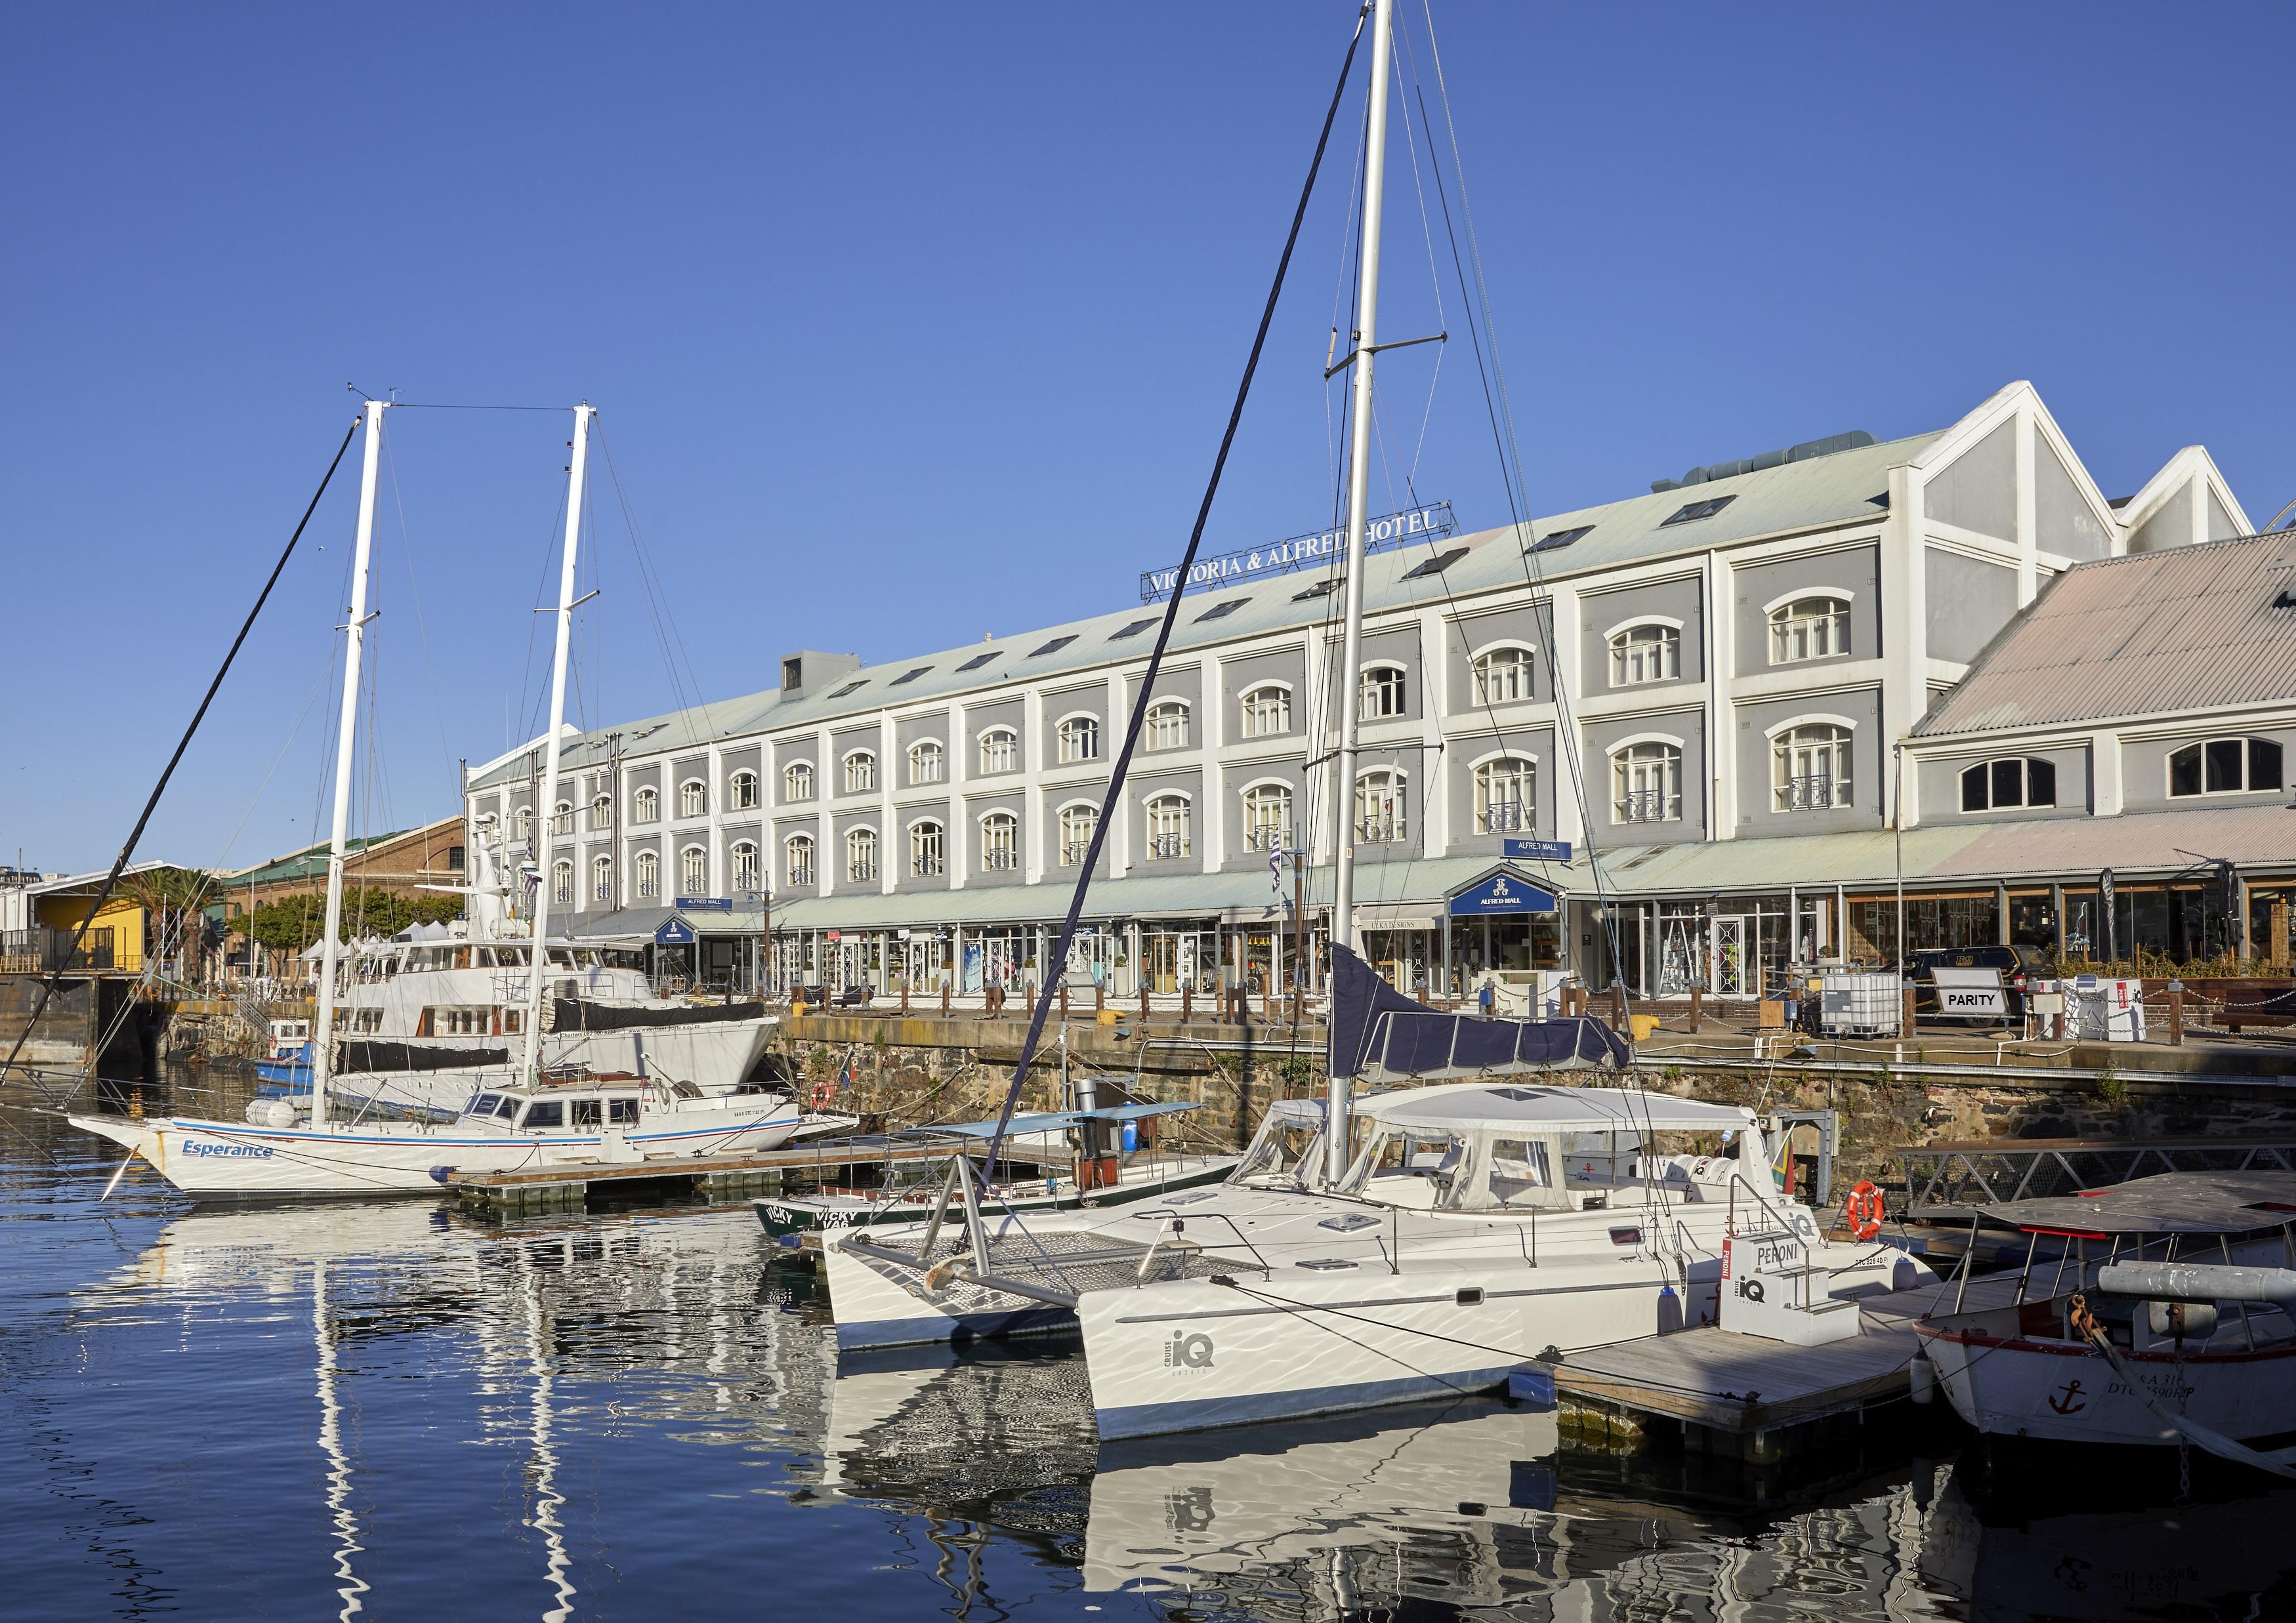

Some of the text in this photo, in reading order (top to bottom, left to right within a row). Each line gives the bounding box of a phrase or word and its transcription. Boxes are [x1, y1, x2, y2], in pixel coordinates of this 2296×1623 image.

[1150, 510, 1438, 591] VICTORIA & ALFRED HOTEL
[1948, 995, 1995, 1006] PARITY
[182, 1140, 274, 1158] Esperance
[1694, 1165, 1705, 1176] iQ
[766, 1206, 793, 1225] VICKY
[816, 1211, 858, 1221] VICKY
[823, 1220, 848, 1229] VA6
[1757, 1243, 1798, 1265] PERONI
[1739, 1275, 1765, 1304] iQ
[1173, 1329, 1215, 1368] iQ
